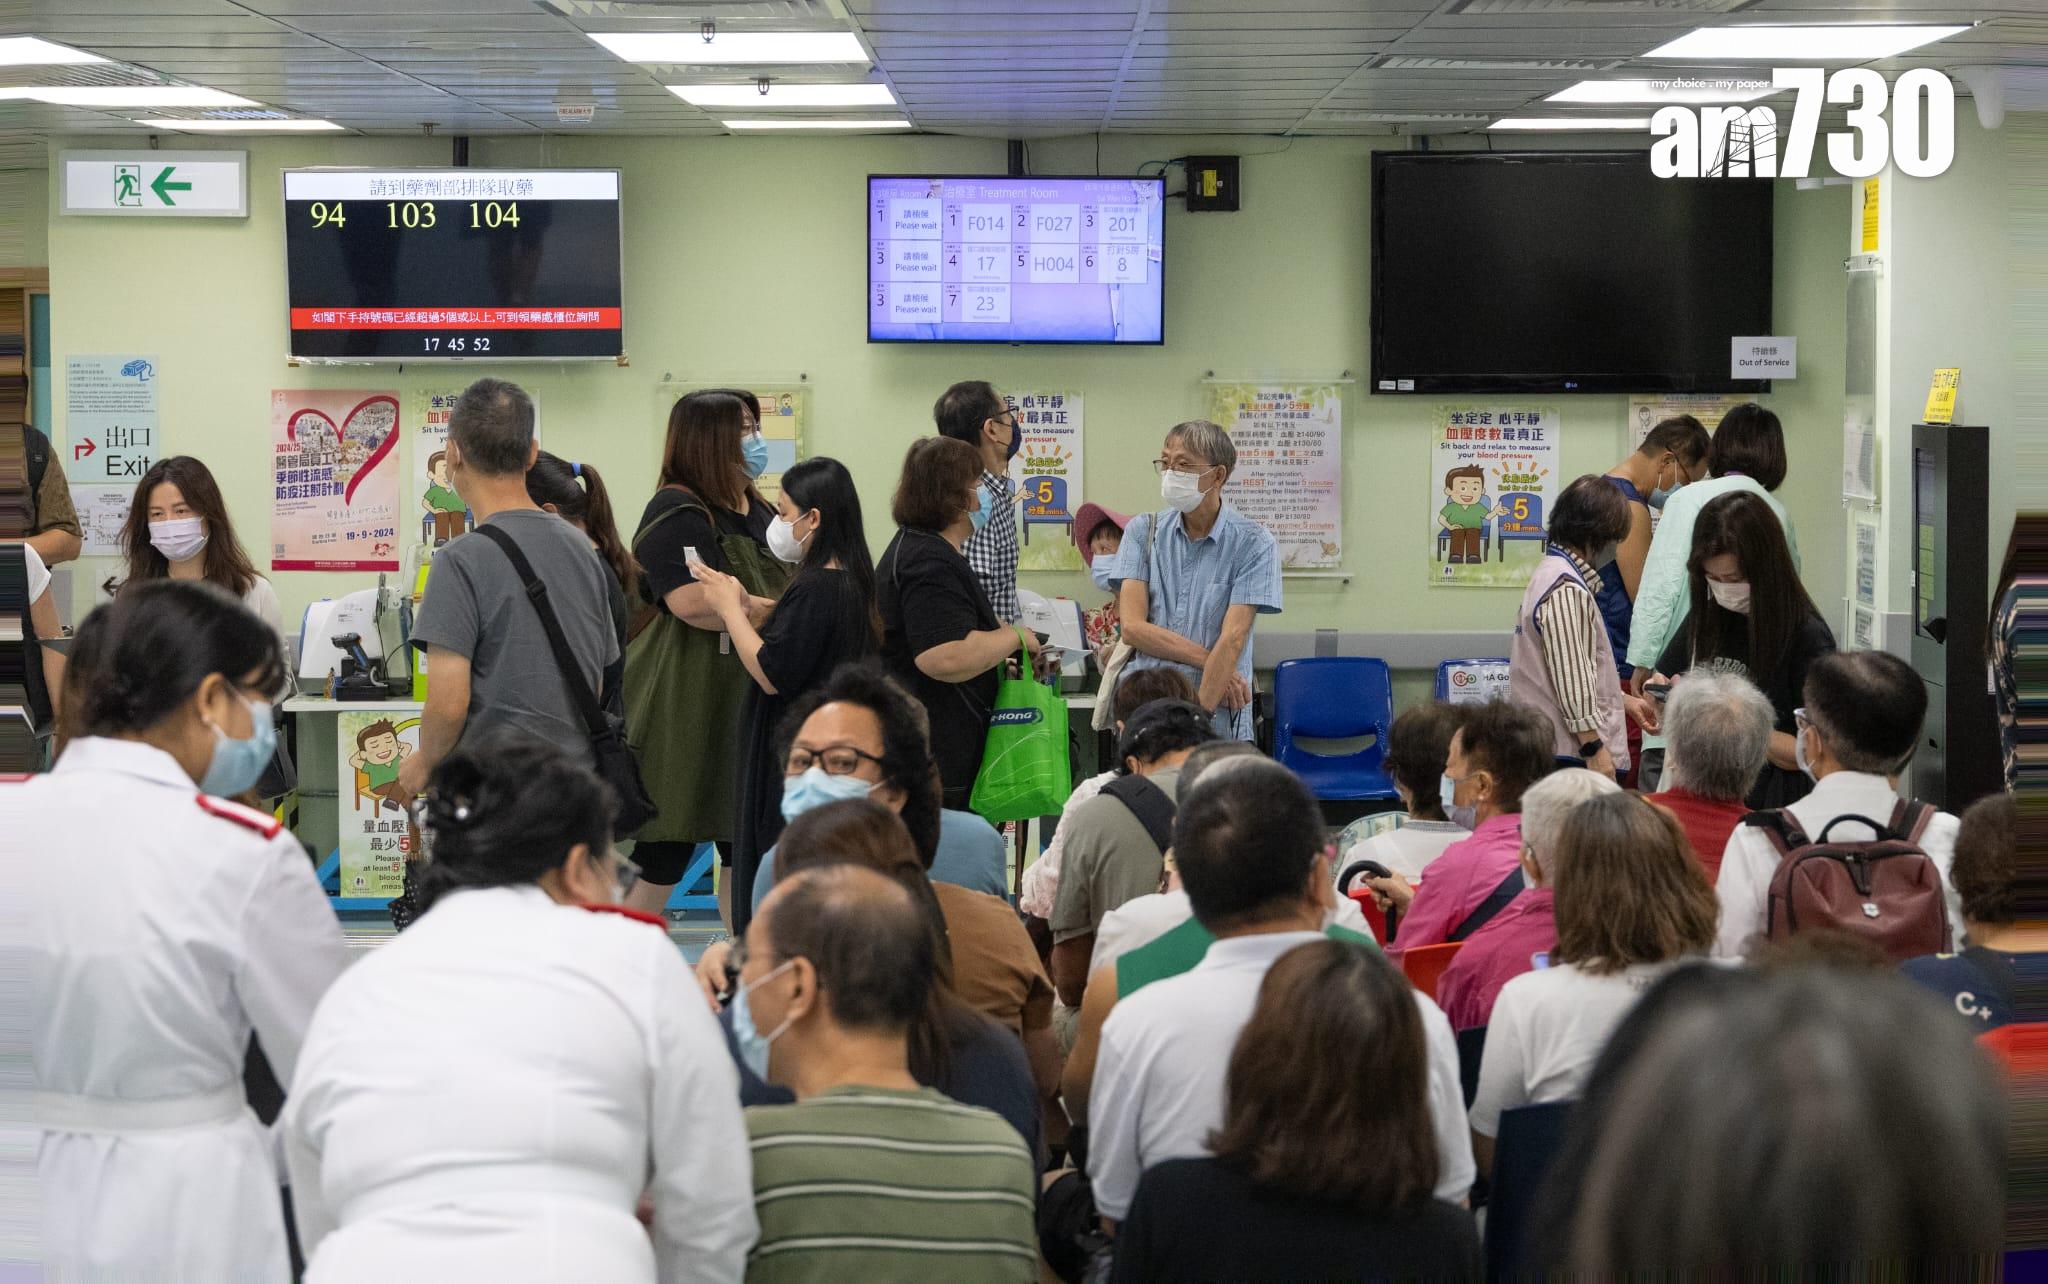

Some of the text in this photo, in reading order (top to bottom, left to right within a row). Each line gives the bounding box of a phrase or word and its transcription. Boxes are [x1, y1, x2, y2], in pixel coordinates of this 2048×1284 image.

[980, 186, 1026, 199] Treatment
[1030, 186, 1058, 199] Room
[310, 202, 520, 228] 94 103 104
[877, 210, 884, 222] 1
[950, 214, 956, 226] 1
[1017, 214, 1025, 227] 2
[1086, 214, 1094, 228] 3
[895, 220, 937, 230] Please wait
[968, 216, 1005, 231] F014
[1036, 216, 1073, 231] F027
[1108, 217, 1135, 231] 201
[876, 251, 885, 265] 3
[948, 254, 957, 267] 4
[977, 256, 995, 271] 17
[1017, 255, 1025, 267] 5
[1034, 256, 1075, 272] H004
[1085, 255, 1094, 268] 6
[1118, 257, 1127, 272] 8
[895, 263, 937, 272] Please wait
[876, 293, 885, 307] 3
[949, 294, 957, 306] 7
[976, 296, 995, 311] 23
[895, 305, 937, 314] Please wait
[424, 338, 490, 352] 17 45 52
[1754, 358, 1762, 366] of
[1763, 358, 1790, 366] Service
[1022, 395, 1065, 408] 心平靜
[1451, 412, 1541, 426] 坐定定 心平靜
[106, 425, 151, 448] 出口
[422, 426, 432, 434] Sit
[1032, 427, 1041, 435] to
[1446, 427, 1544, 441] 血壓度數最真正
[1024, 436, 1057, 444] pressure
[1440, 442, 1451, 450] Sit
[1488, 443, 1507, 451] relax
[106, 455, 150, 476] Exit
[276, 467, 333, 484] 季節性流感
[1242, 478, 1266, 487] REST
[276, 481, 344, 500] 防疫注射計劃
[1037, 481, 1053, 504] 5
[1513, 497, 1529, 520] 5
[1497, 673, 1510, 681] Go
[392, 862, 400, 872] 5
